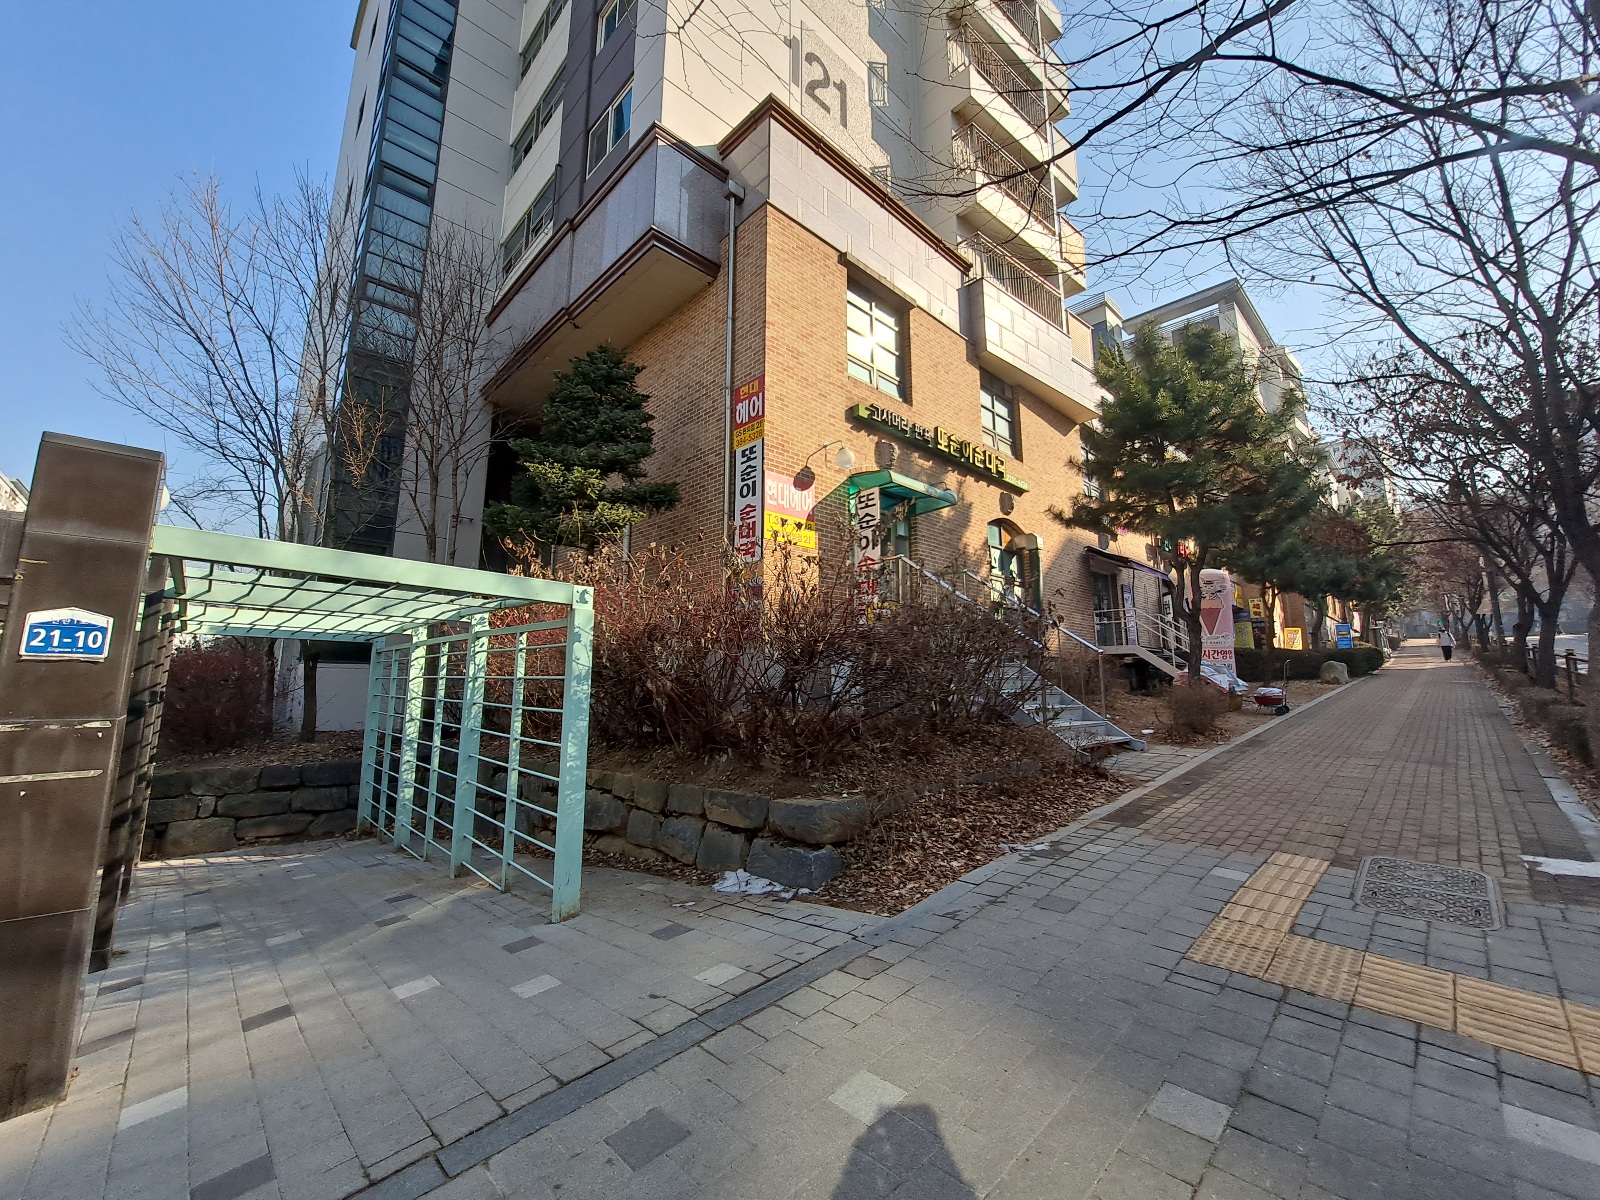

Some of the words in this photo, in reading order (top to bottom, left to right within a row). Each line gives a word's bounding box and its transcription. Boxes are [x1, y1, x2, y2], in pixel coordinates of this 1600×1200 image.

[783, 34, 848, 130] 121
[739, 380, 759, 399] 현대
[735, 392, 763, 424] 헤어
[739, 444, 757, 499] 또순이
[766, 479, 813, 515] 현대헤어
[857, 492, 877, 550] 또순이
[29, 628, 103, 649] 21-10
